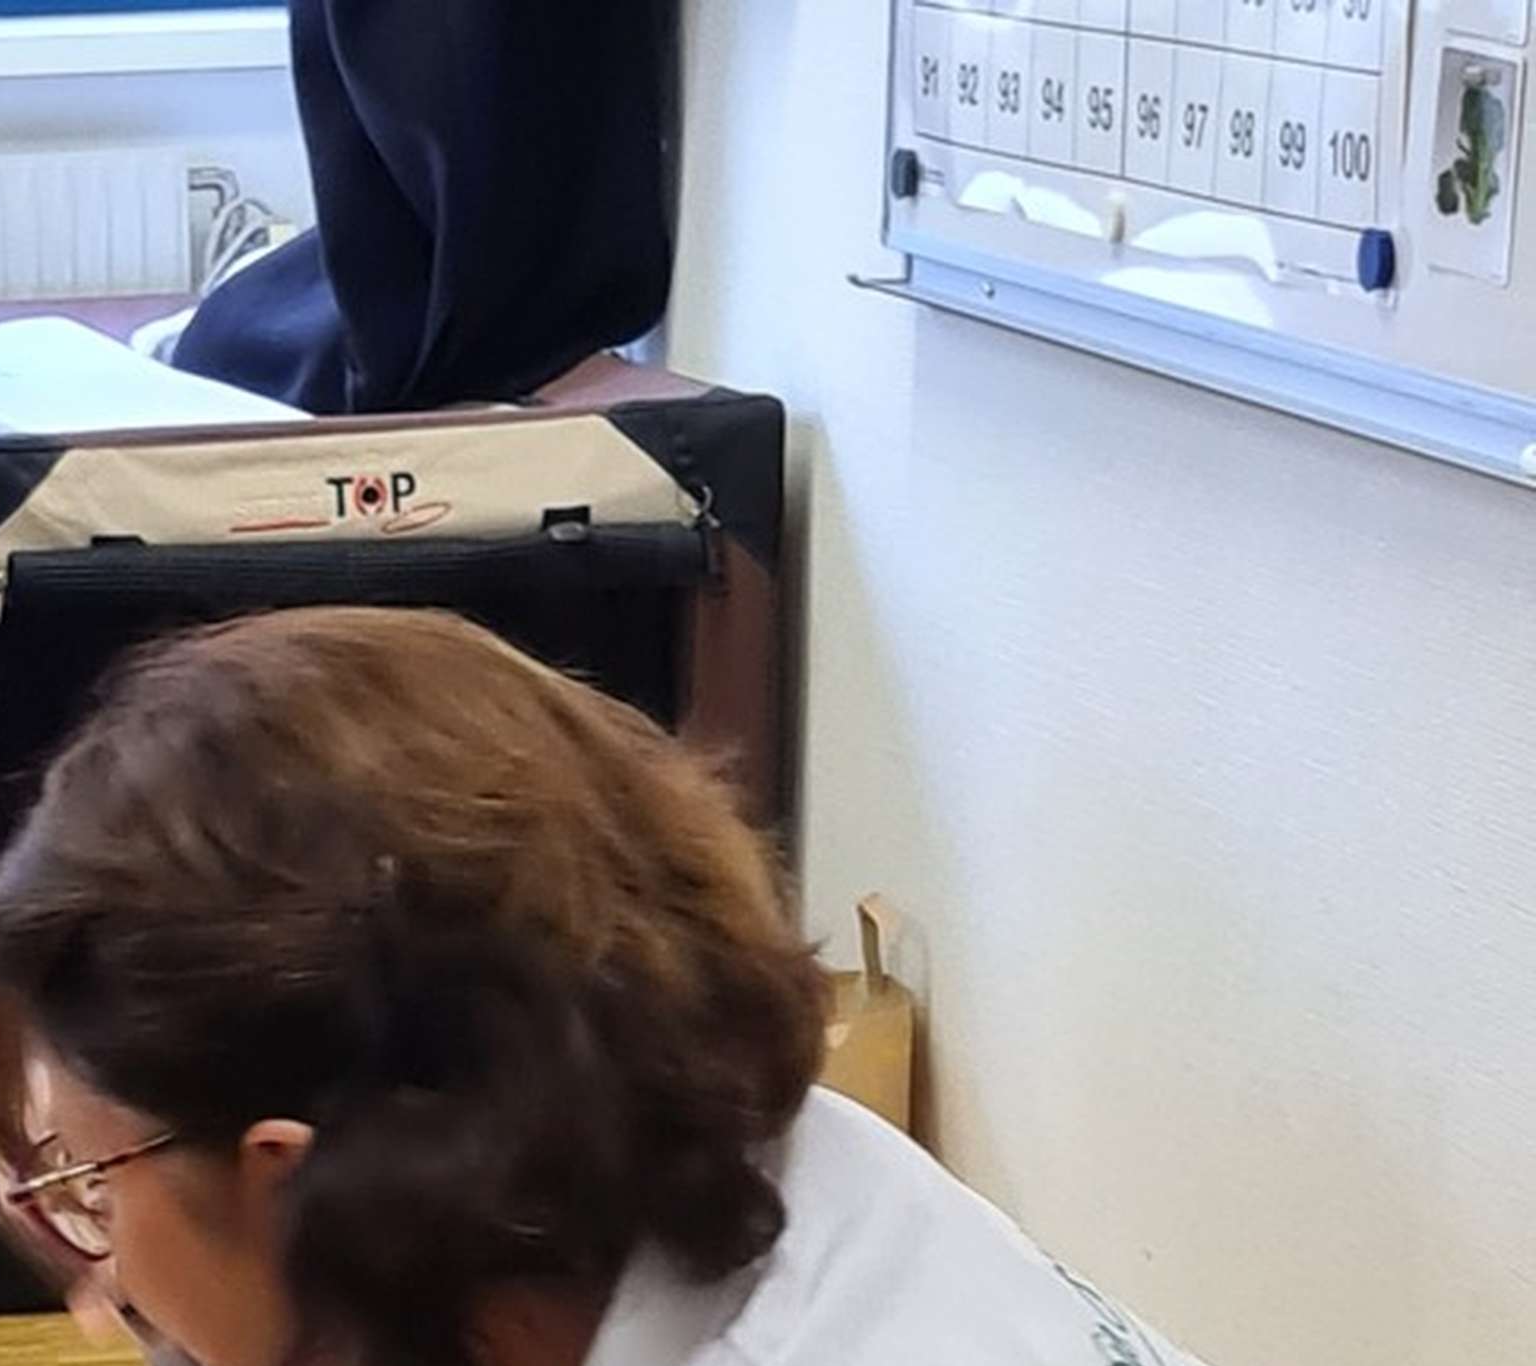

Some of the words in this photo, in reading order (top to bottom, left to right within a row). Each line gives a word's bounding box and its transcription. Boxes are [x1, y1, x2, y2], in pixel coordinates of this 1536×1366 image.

[921, 55, 939, 97] 91
[958, 63, 978, 106] 92
[997, 71, 1020, 114] 93
[1042, 78, 1064, 122] 94
[1088, 86, 1113, 131] 95
[1137, 94, 1161, 140] 96
[1183, 102, 1208, 149] 97
[1230, 109, 1255, 158] 98
[1279, 120, 1306, 170] 99
[1328, 129, 1372, 182] 100
[326, 472, 416, 518] TOP
